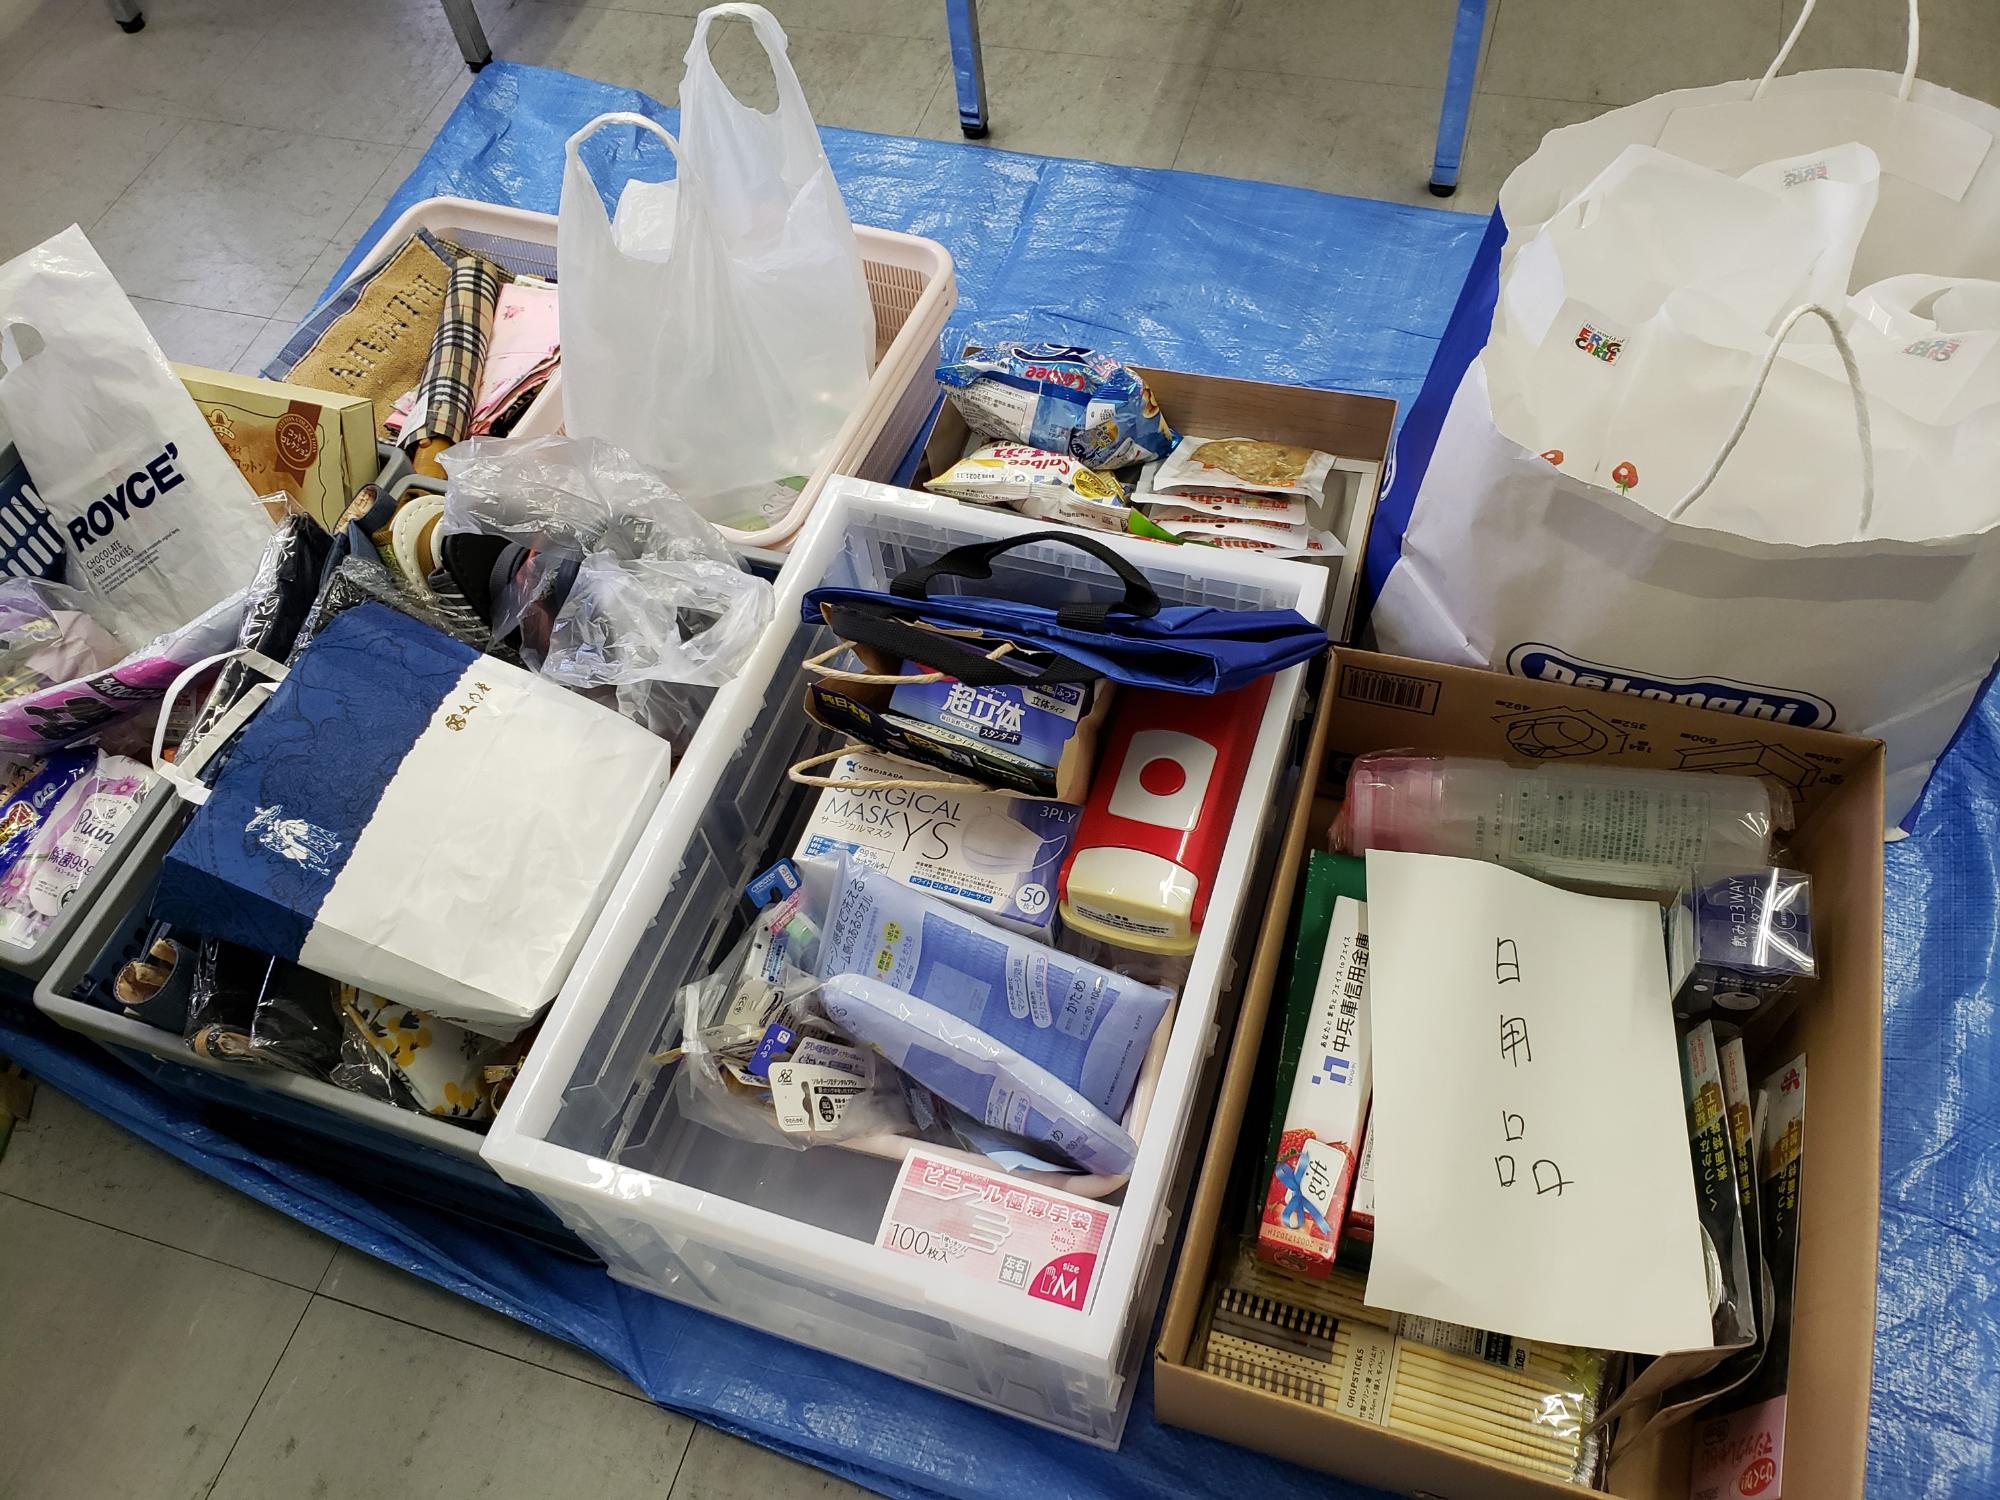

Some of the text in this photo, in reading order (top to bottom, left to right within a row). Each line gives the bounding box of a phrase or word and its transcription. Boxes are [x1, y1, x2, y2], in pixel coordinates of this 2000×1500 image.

[1575, 338, 1616, 364] CARLE
[1579, 327, 1622, 353] ERIC
[281, 435, 309, 457] コレクション
[288, 428, 308, 444] コットン
[1008, 459, 1070, 475] Calbee
[66, 441, 185, 553] ROYCE'
[86, 539, 123, 570] CHOCOLATE
[92, 544, 134, 579] AND COOKIES
[1030, 696, 1067, 714] 立体タイプ
[1057, 687, 1078, 701] ふつう
[941, 682, 1026, 734] 超立体
[980, 727, 1021, 744] スタンダード
[833, 775, 962, 822] SURGICAL
[820, 815, 893, 840] サージカルマスク
[824, 796, 960, 861] MASK YS
[1039, 805, 1078, 826] 3PLY
[909, 876, 994, 904] ホワイト ゴムタイプ フリーサイズ
[1020, 885, 1046, 907] 50
[1022, 902, 1038, 913] 枚入
[1729, 876, 1744, 949] 飲み口3WAY
[1065, 980, 1086, 1015] かため
[1332, 931, 1370, 1053] 中兵庫信用金庫
[760, 1038, 775, 1058] ふつう
[1495, 937, 1575, 1197] 日用品
[1305, 1157, 1332, 1202] gift
[922, 1166, 1093, 1233] ビニール極薄手袋
[890, 1222, 949, 1264] 100枚入
[1001, 1267, 1024, 1285] 兼用
[1004, 1254, 1028, 1272] 左右
[1061, 1261, 1081, 1275] size
[1052, 1272, 1079, 1303] M
[1346, 1347, 1365, 1409] CHOPSTICKS
